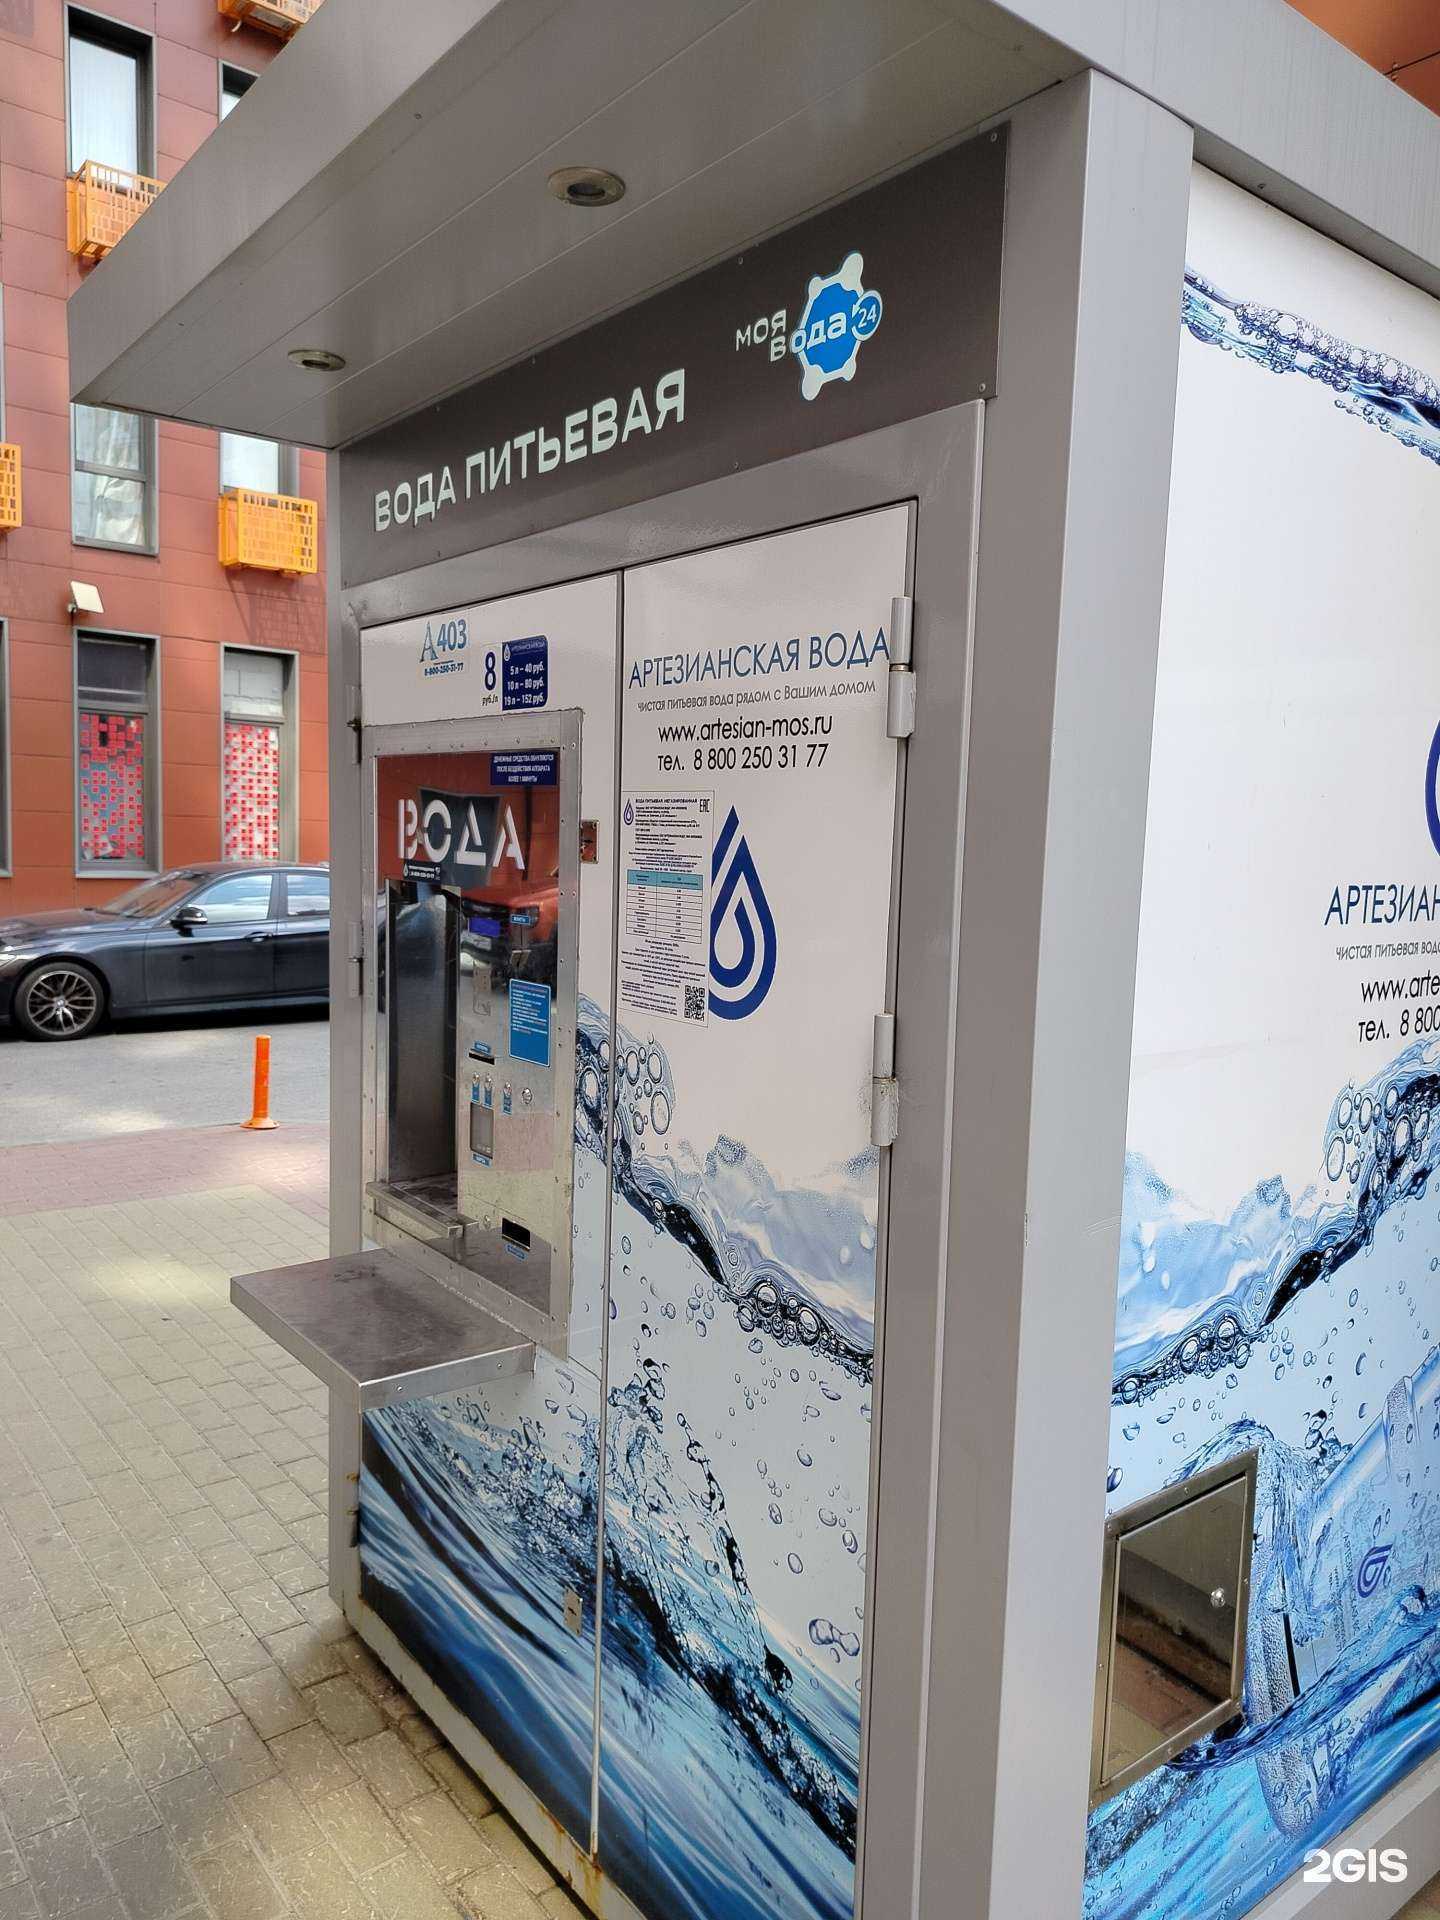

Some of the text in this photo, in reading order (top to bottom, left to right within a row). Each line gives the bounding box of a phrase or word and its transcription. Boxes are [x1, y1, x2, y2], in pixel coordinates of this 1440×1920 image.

[858, 304, 877, 329] 24
[375, 368, 686, 532] ВОДА ПИТЬЕВАЯ
[484, 651, 497, 691] 8
[510, 665, 515, 676] 5
[525, 663, 532, 673] 40
[533, 661, 545, 675] руб.
[628, 627, 890, 689] АРТЕЗИАНСКАЯ ВОДА
[504, 696, 511, 706] 19
[522, 693, 532, 704] 152
[533, 692, 545, 705] руб.
[507, 681, 514, 690] 10
[533, 677, 545, 690] руб.
[637, 680, 876, 712] чистая питьевая вода рядом с Вашим домом
[658, 715, 832, 742] www.artesian-mos.ru
[657, 743, 829, 771] тел. 8 800 250 31 77
[398, 798, 525, 870] ВОДА
[1324, 884, 1440, 926] АРТЕЗИАН
[1335, 945, 1372, 961] чистая
[1374, 941, 1419, 959] питьевая
[1361, 969, 1440, 1003] www.arte
[1358, 1005, 1440, 1042] тел. 8 800
